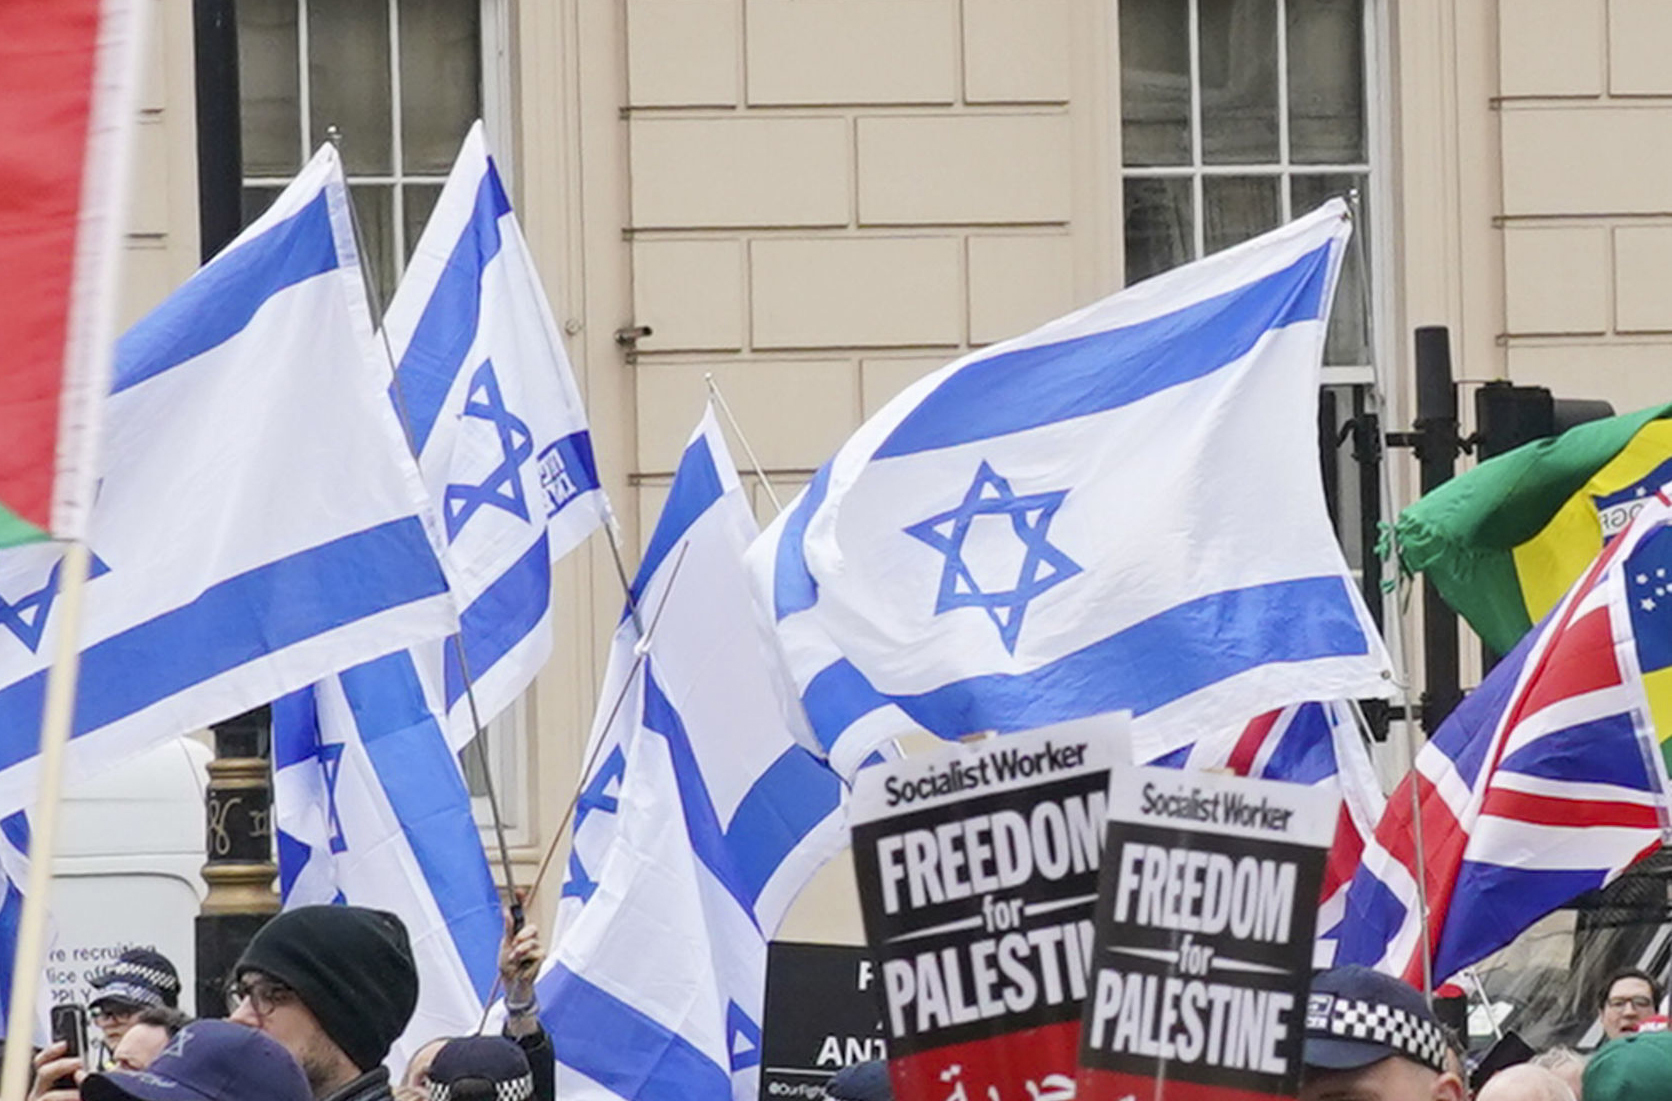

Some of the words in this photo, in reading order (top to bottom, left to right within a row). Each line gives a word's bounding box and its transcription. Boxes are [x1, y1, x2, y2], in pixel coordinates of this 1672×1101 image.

[885, 757, 989, 806] Socialist
[991, 741, 1088, 782] Worker
[1140, 782, 1221, 823] Socialist
[1223, 792, 1295, 832] Worker
[877, 790, 1110, 915] FREEDOM
[1113, 842, 1298, 944] FREEDOM
[982, 893, 1024, 933] for
[882, 919, 1095, 1039] PALESTI
[1179, 935, 1215, 976] for
[1089, 968, 1295, 1075] PALESTINE
